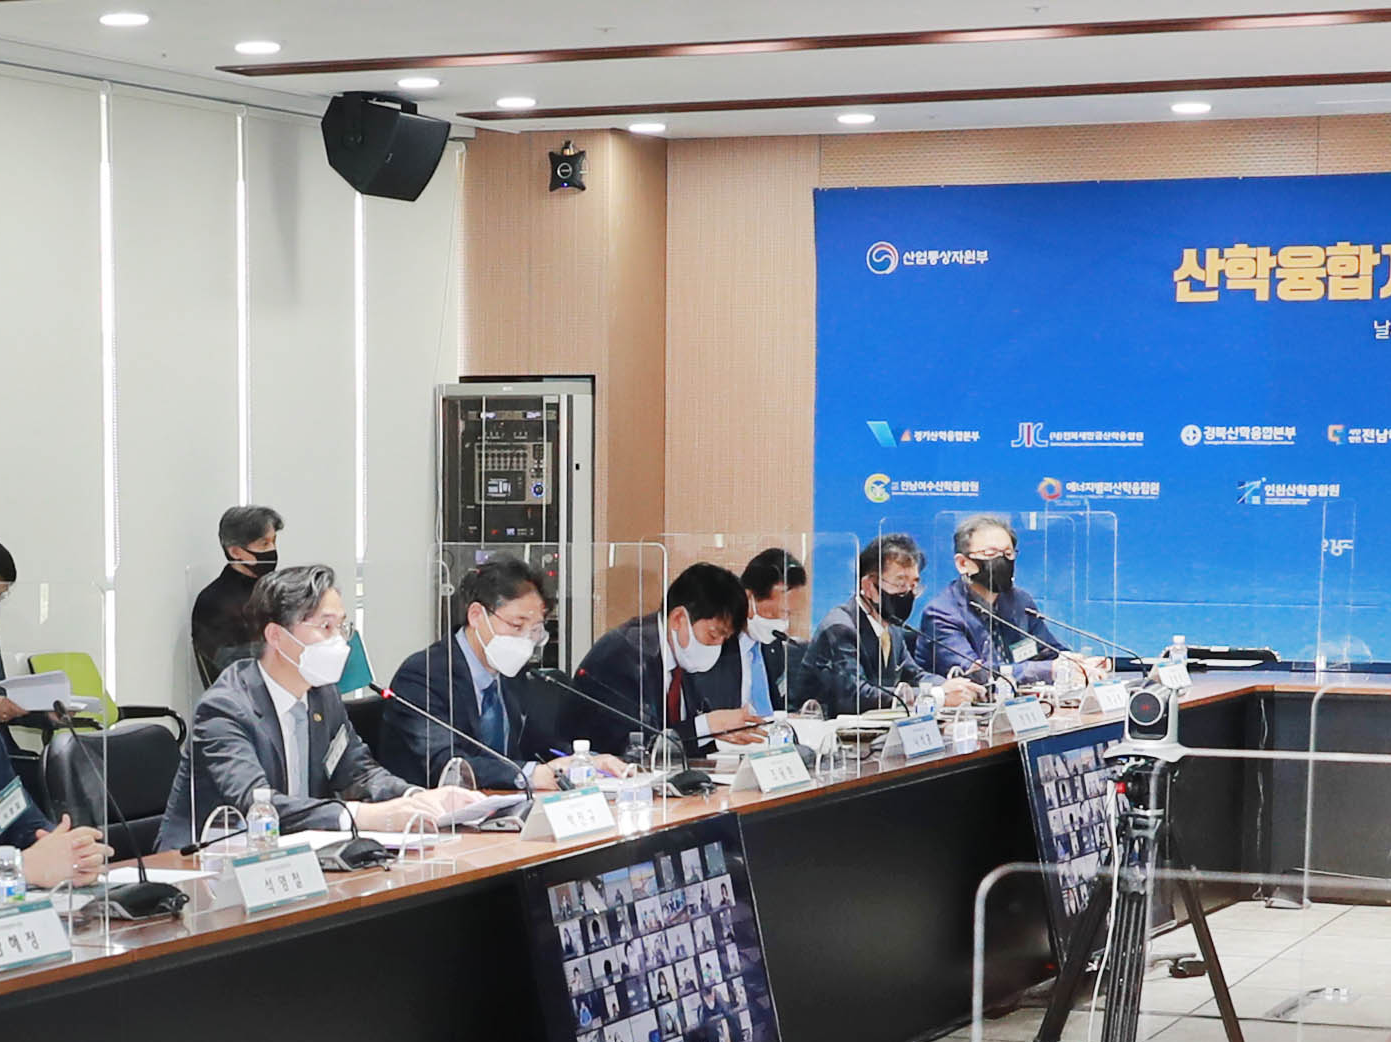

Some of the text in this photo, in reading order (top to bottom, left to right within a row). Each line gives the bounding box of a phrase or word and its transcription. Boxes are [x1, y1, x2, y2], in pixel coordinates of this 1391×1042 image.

[902, 250, 989, 266] 산업통상자원부
[913, 430, 981, 442] 경기산학융합본부
[1203, 426, 1297, 441] 경북산학융합본부
[1264, 484, 1341, 497] 인천산학융합원
